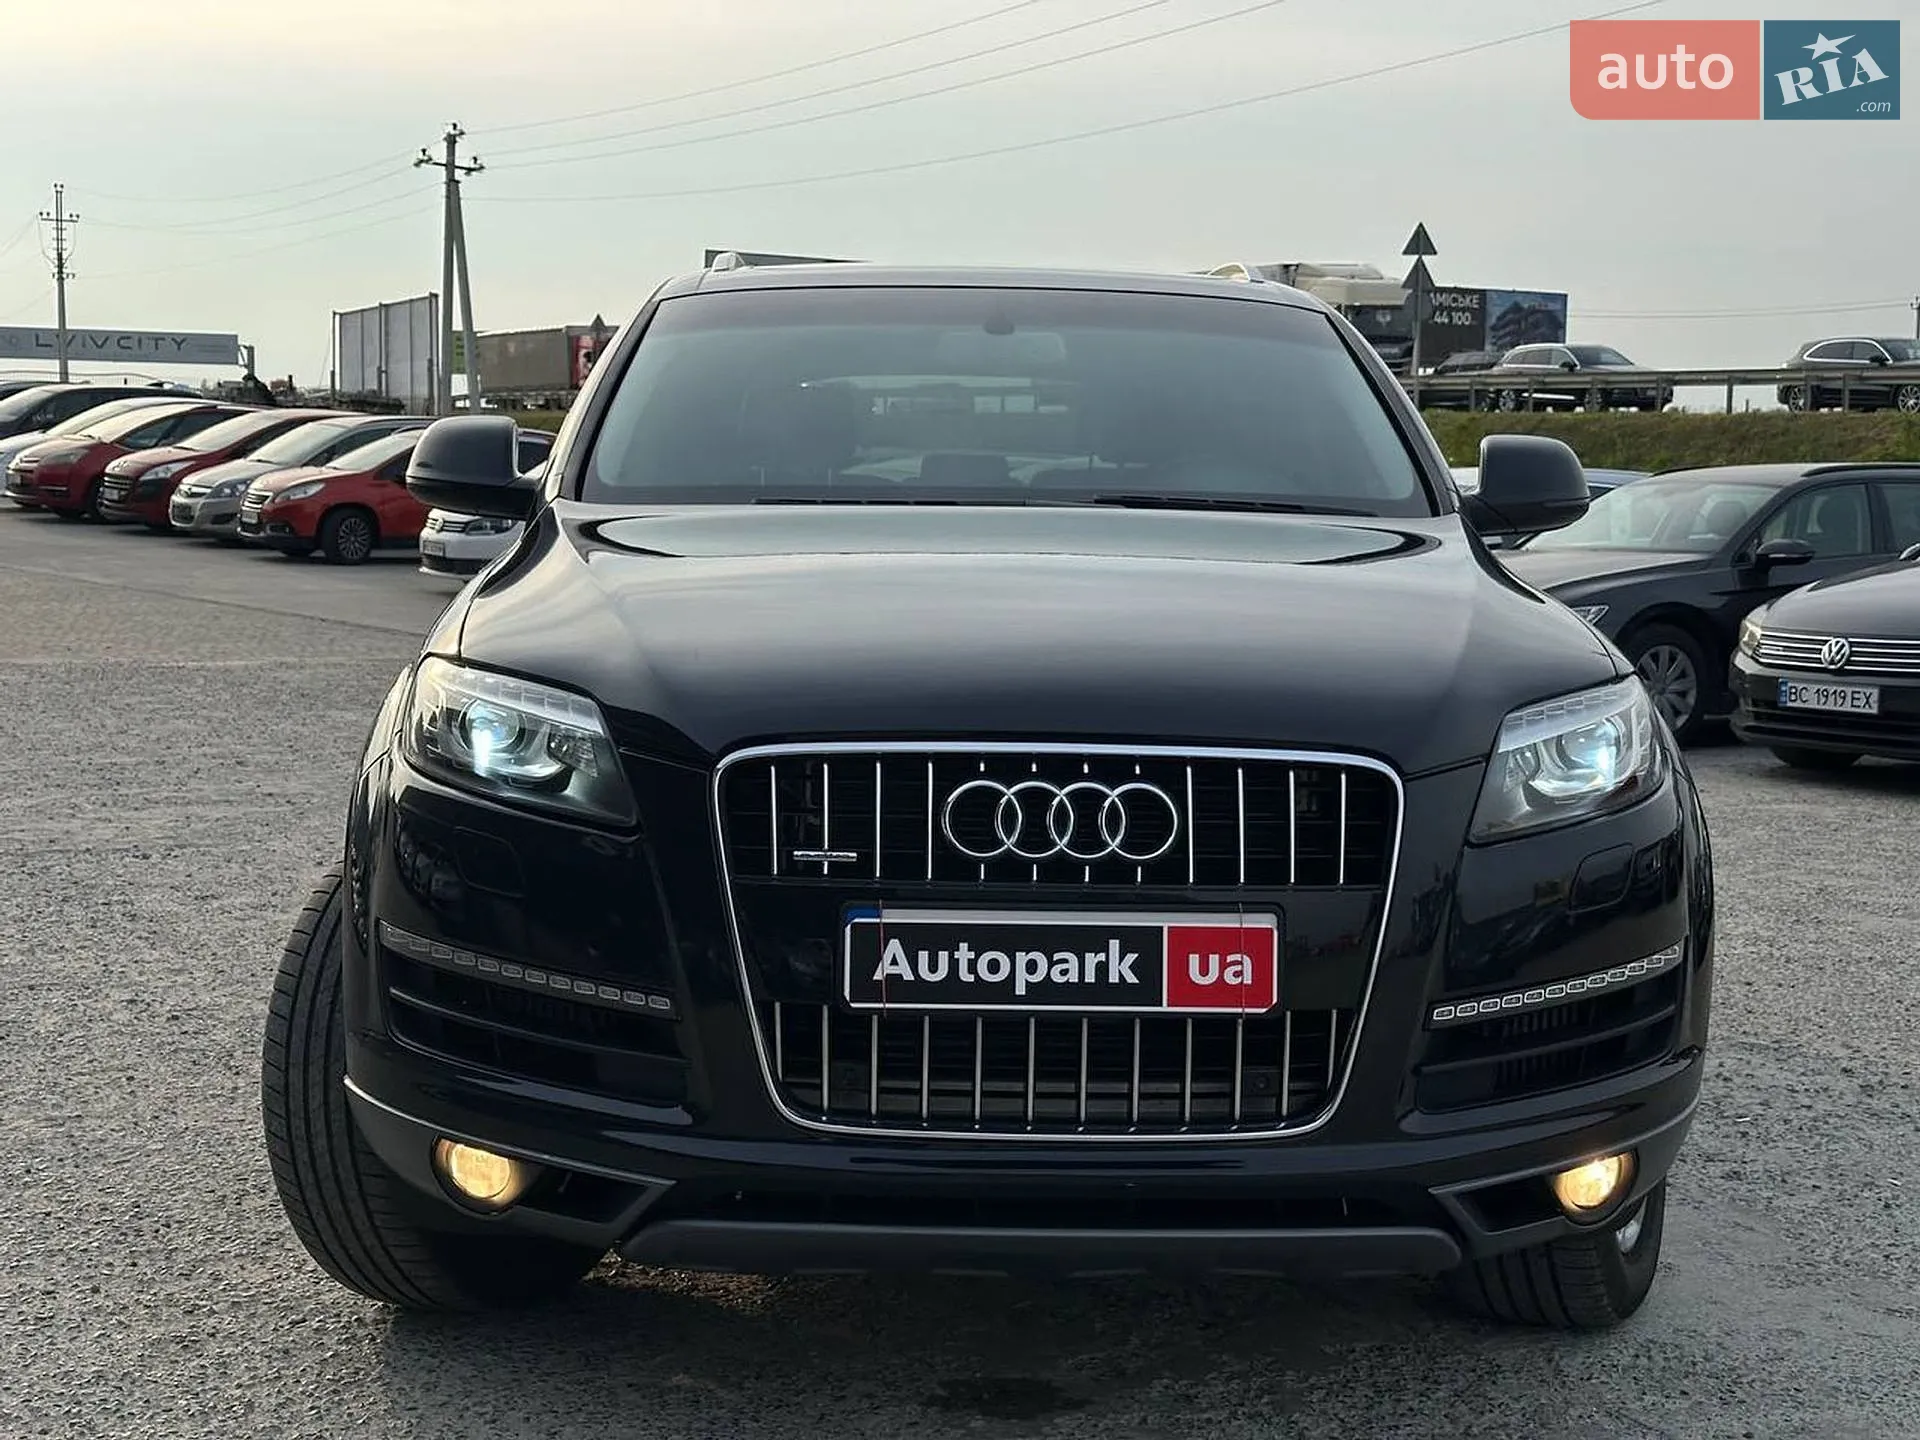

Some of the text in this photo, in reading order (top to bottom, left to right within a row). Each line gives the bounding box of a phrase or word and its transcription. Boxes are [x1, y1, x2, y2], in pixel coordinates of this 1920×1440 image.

[1451, 311, 1472, 325] 100
[1788, 686, 1809, 703] BC
[1814, 688, 1847, 707] 1919
[1851, 690, 1873, 709] EX
[873, 938, 1253, 995] Autopark ua
